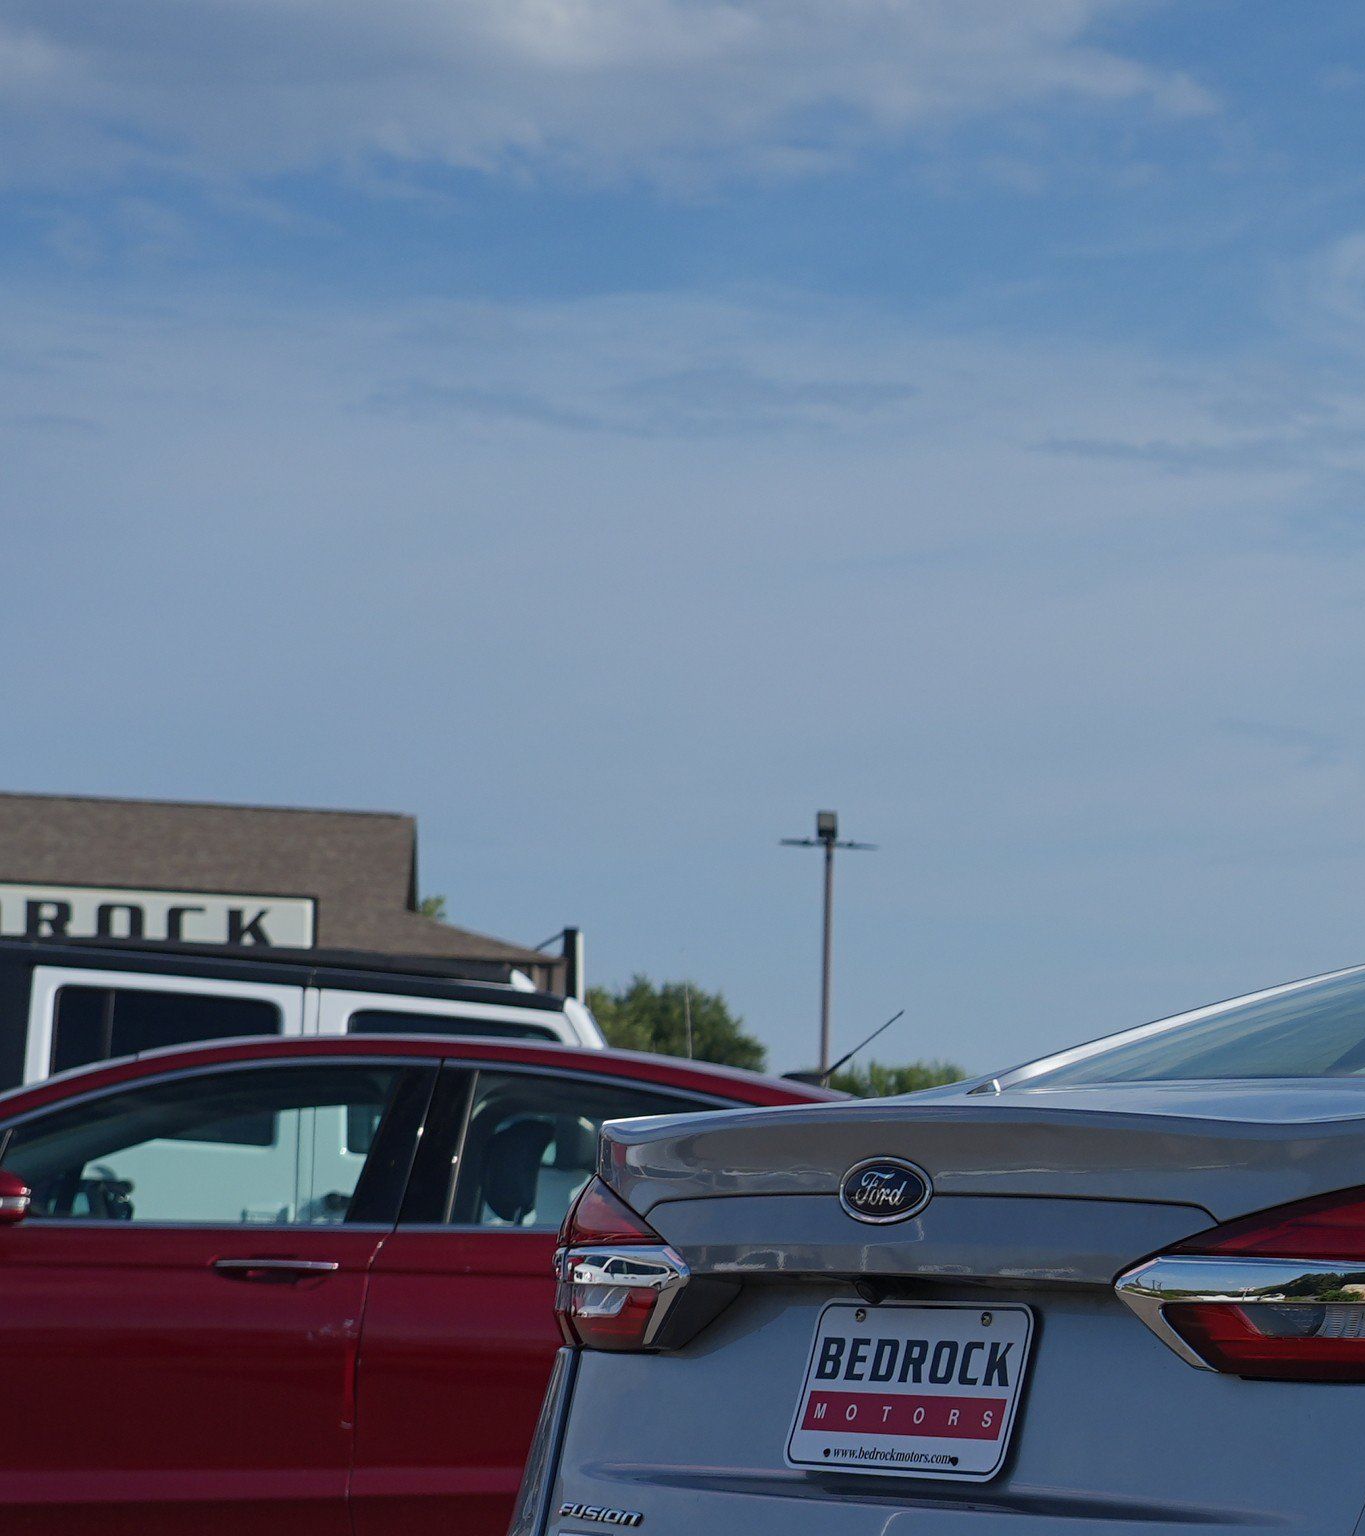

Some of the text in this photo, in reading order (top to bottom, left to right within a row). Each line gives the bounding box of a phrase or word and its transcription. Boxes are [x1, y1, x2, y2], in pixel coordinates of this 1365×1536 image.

[852, 1171, 907, 1206] Ford
[815, 1337, 1015, 1387] BEDROCK
[813, 1402, 994, 1429] MOTORS
[833, 1446, 952, 1465] www.bedrockmotors.com
[559, 1502, 644, 1527] FUSION
